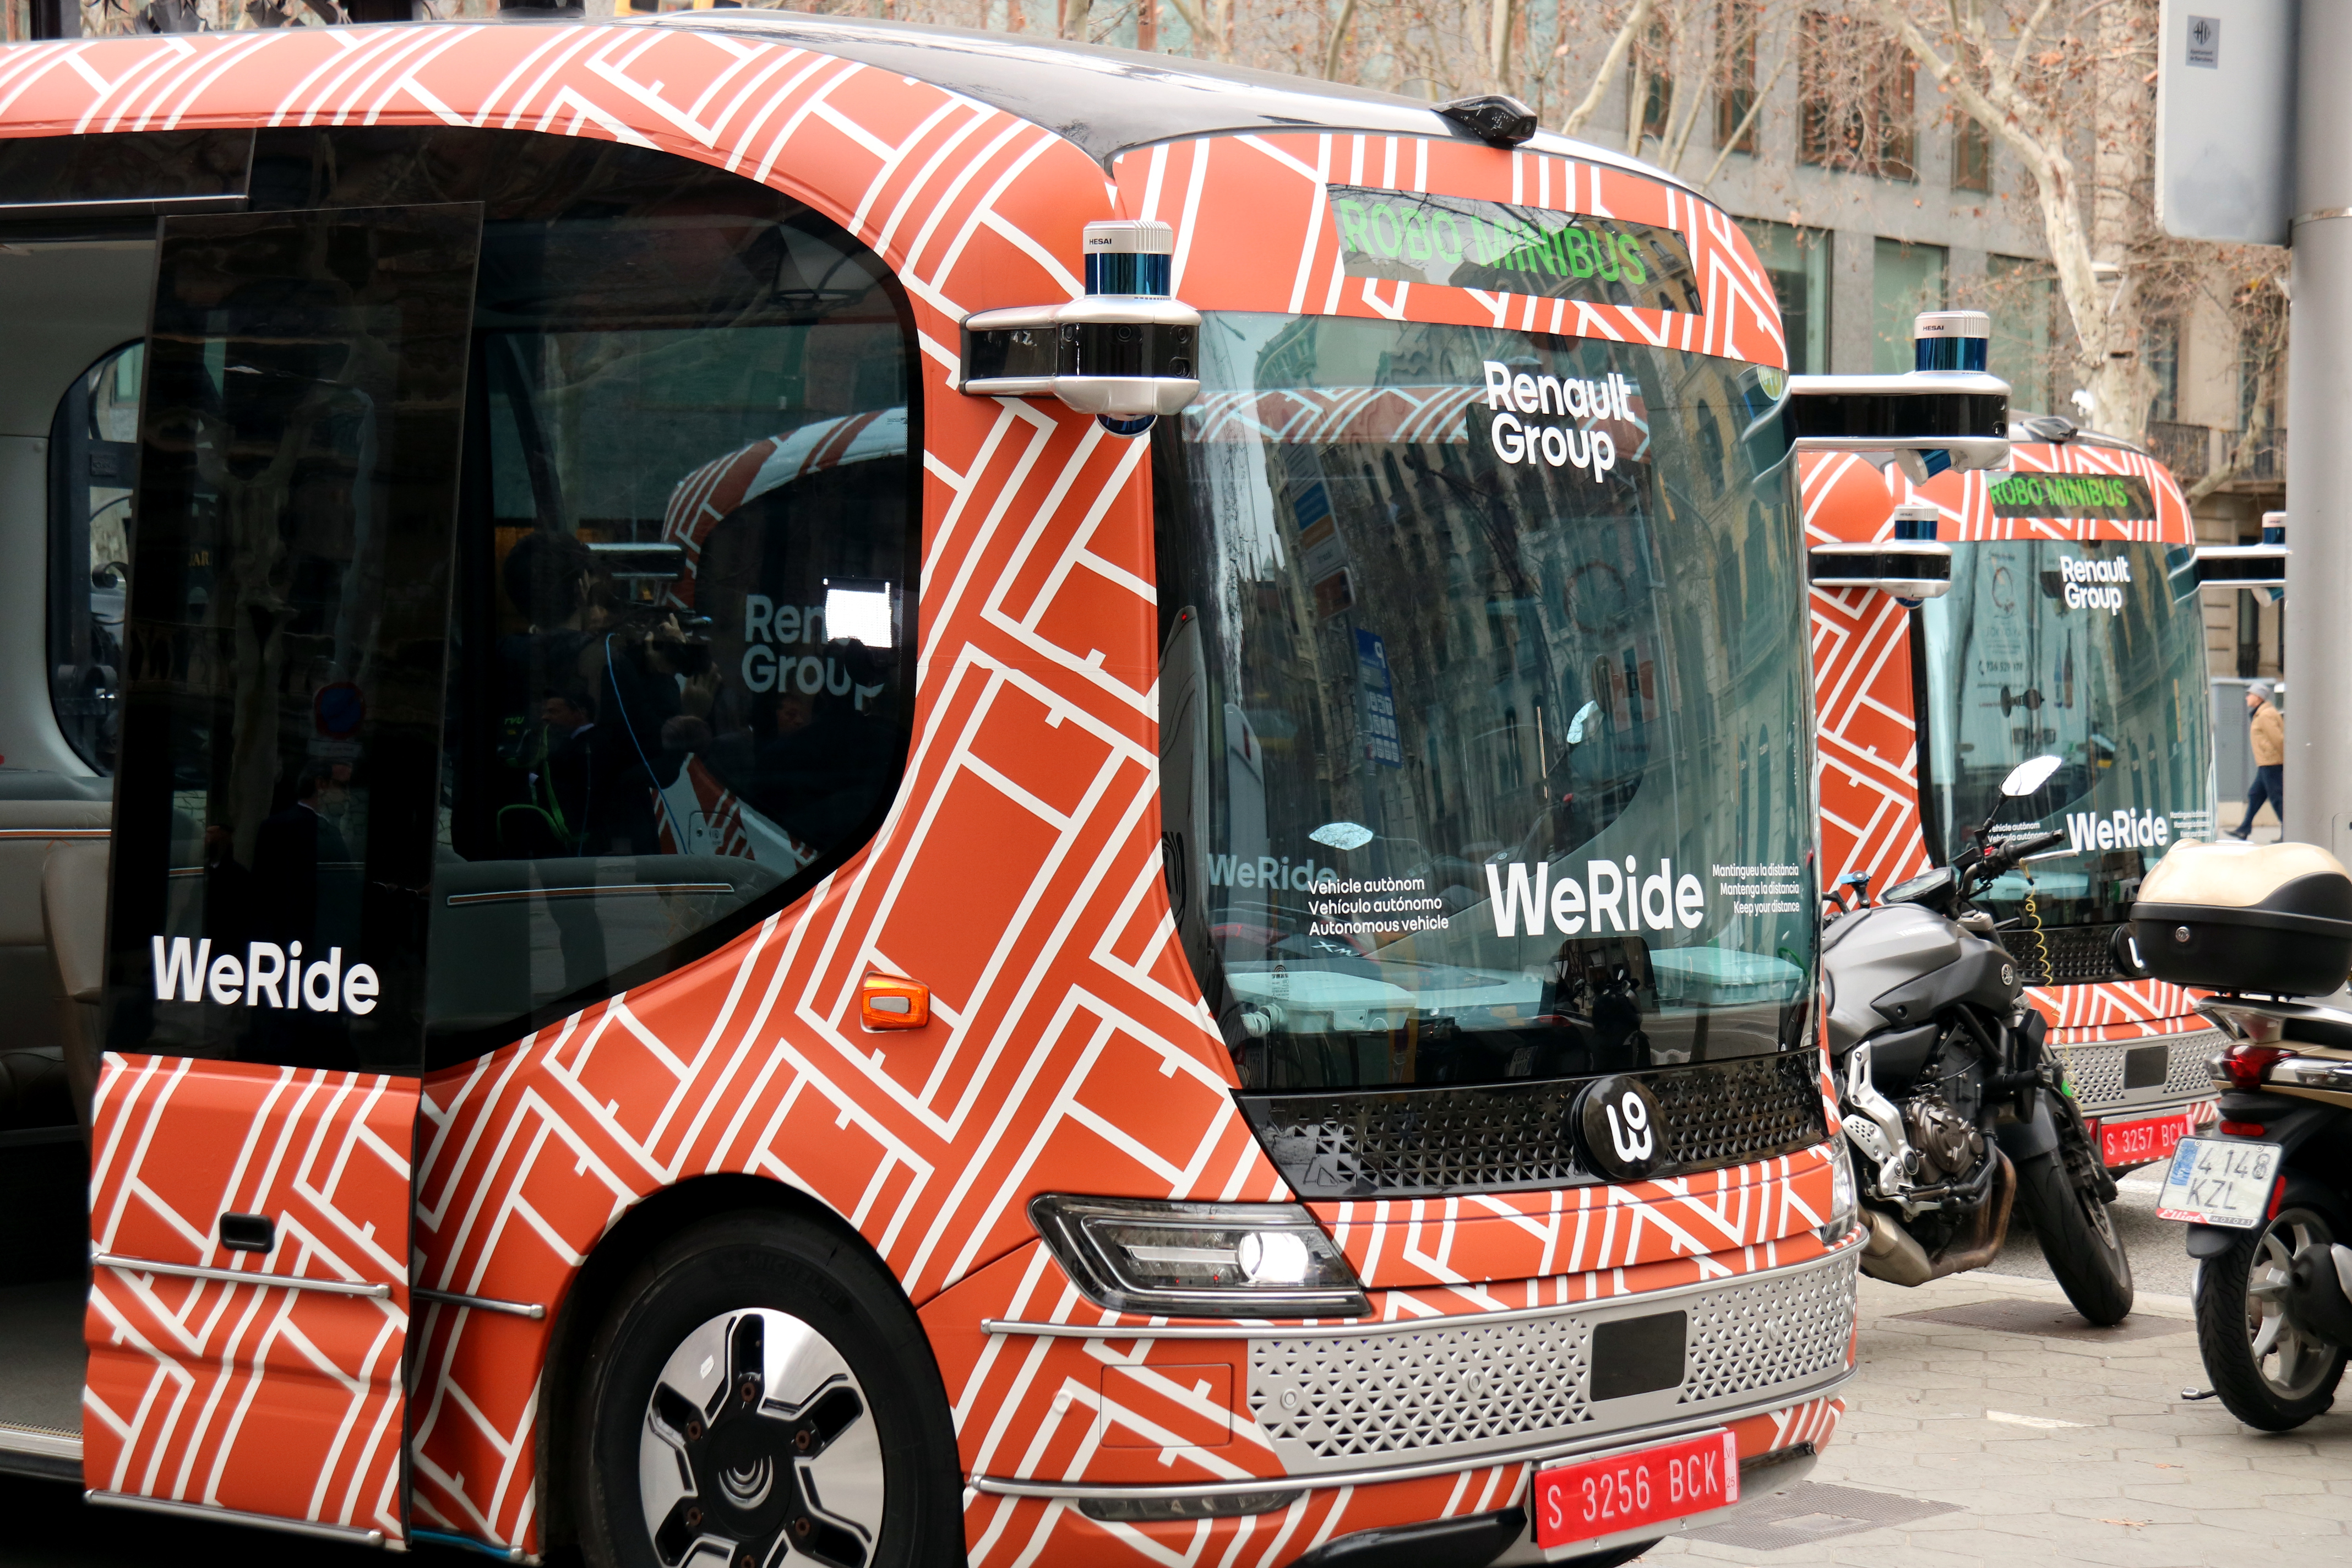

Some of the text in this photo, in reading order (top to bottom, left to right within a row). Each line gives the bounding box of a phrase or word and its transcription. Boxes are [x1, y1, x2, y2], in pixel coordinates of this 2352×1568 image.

[1340, 199, 1647, 285] ROBO MINIBUS
[1483, 361, 1636, 422] Renault
[1491, 412, 1616, 483] Group
[1986, 476, 2128, 507] ROBO MINIBUS
[2060, 555, 2131, 583] Renault
[2065, 582, 2122, 616] Group
[1988, 823, 2012, 833] ehicle
[2066, 807, 2168, 851] WeRide
[1208, 853, 1337, 892] WeRide
[1308, 876, 1425, 895] Vehicle autònom
[1712, 863, 1799, 880] Mantingueu la distància
[1485, 854, 1704, 937] WeRide
[1721, 881, 1799, 899] Mantenga la distancia
[1308, 896, 1442, 915] Vehículo autónomo
[1734, 900, 1800, 917] Keep your distance
[1309, 914, 1449, 936] Autonomous vehicle
[1896, 925, 1937, 937] YAMAHA
[154, 935, 379, 1015] WeRide
[2106, 1122, 2185, 1156] S 3257 BCK
[2186, 1177, 2236, 1210] KZL
[2158, 1209, 2251, 1226] Elliot MOTORS
[1725, 1446, 1733, 1458] VI
[1547, 1450, 1718, 1529] S 3256 BCK
[1727, 1476, 1735, 1488] 25
